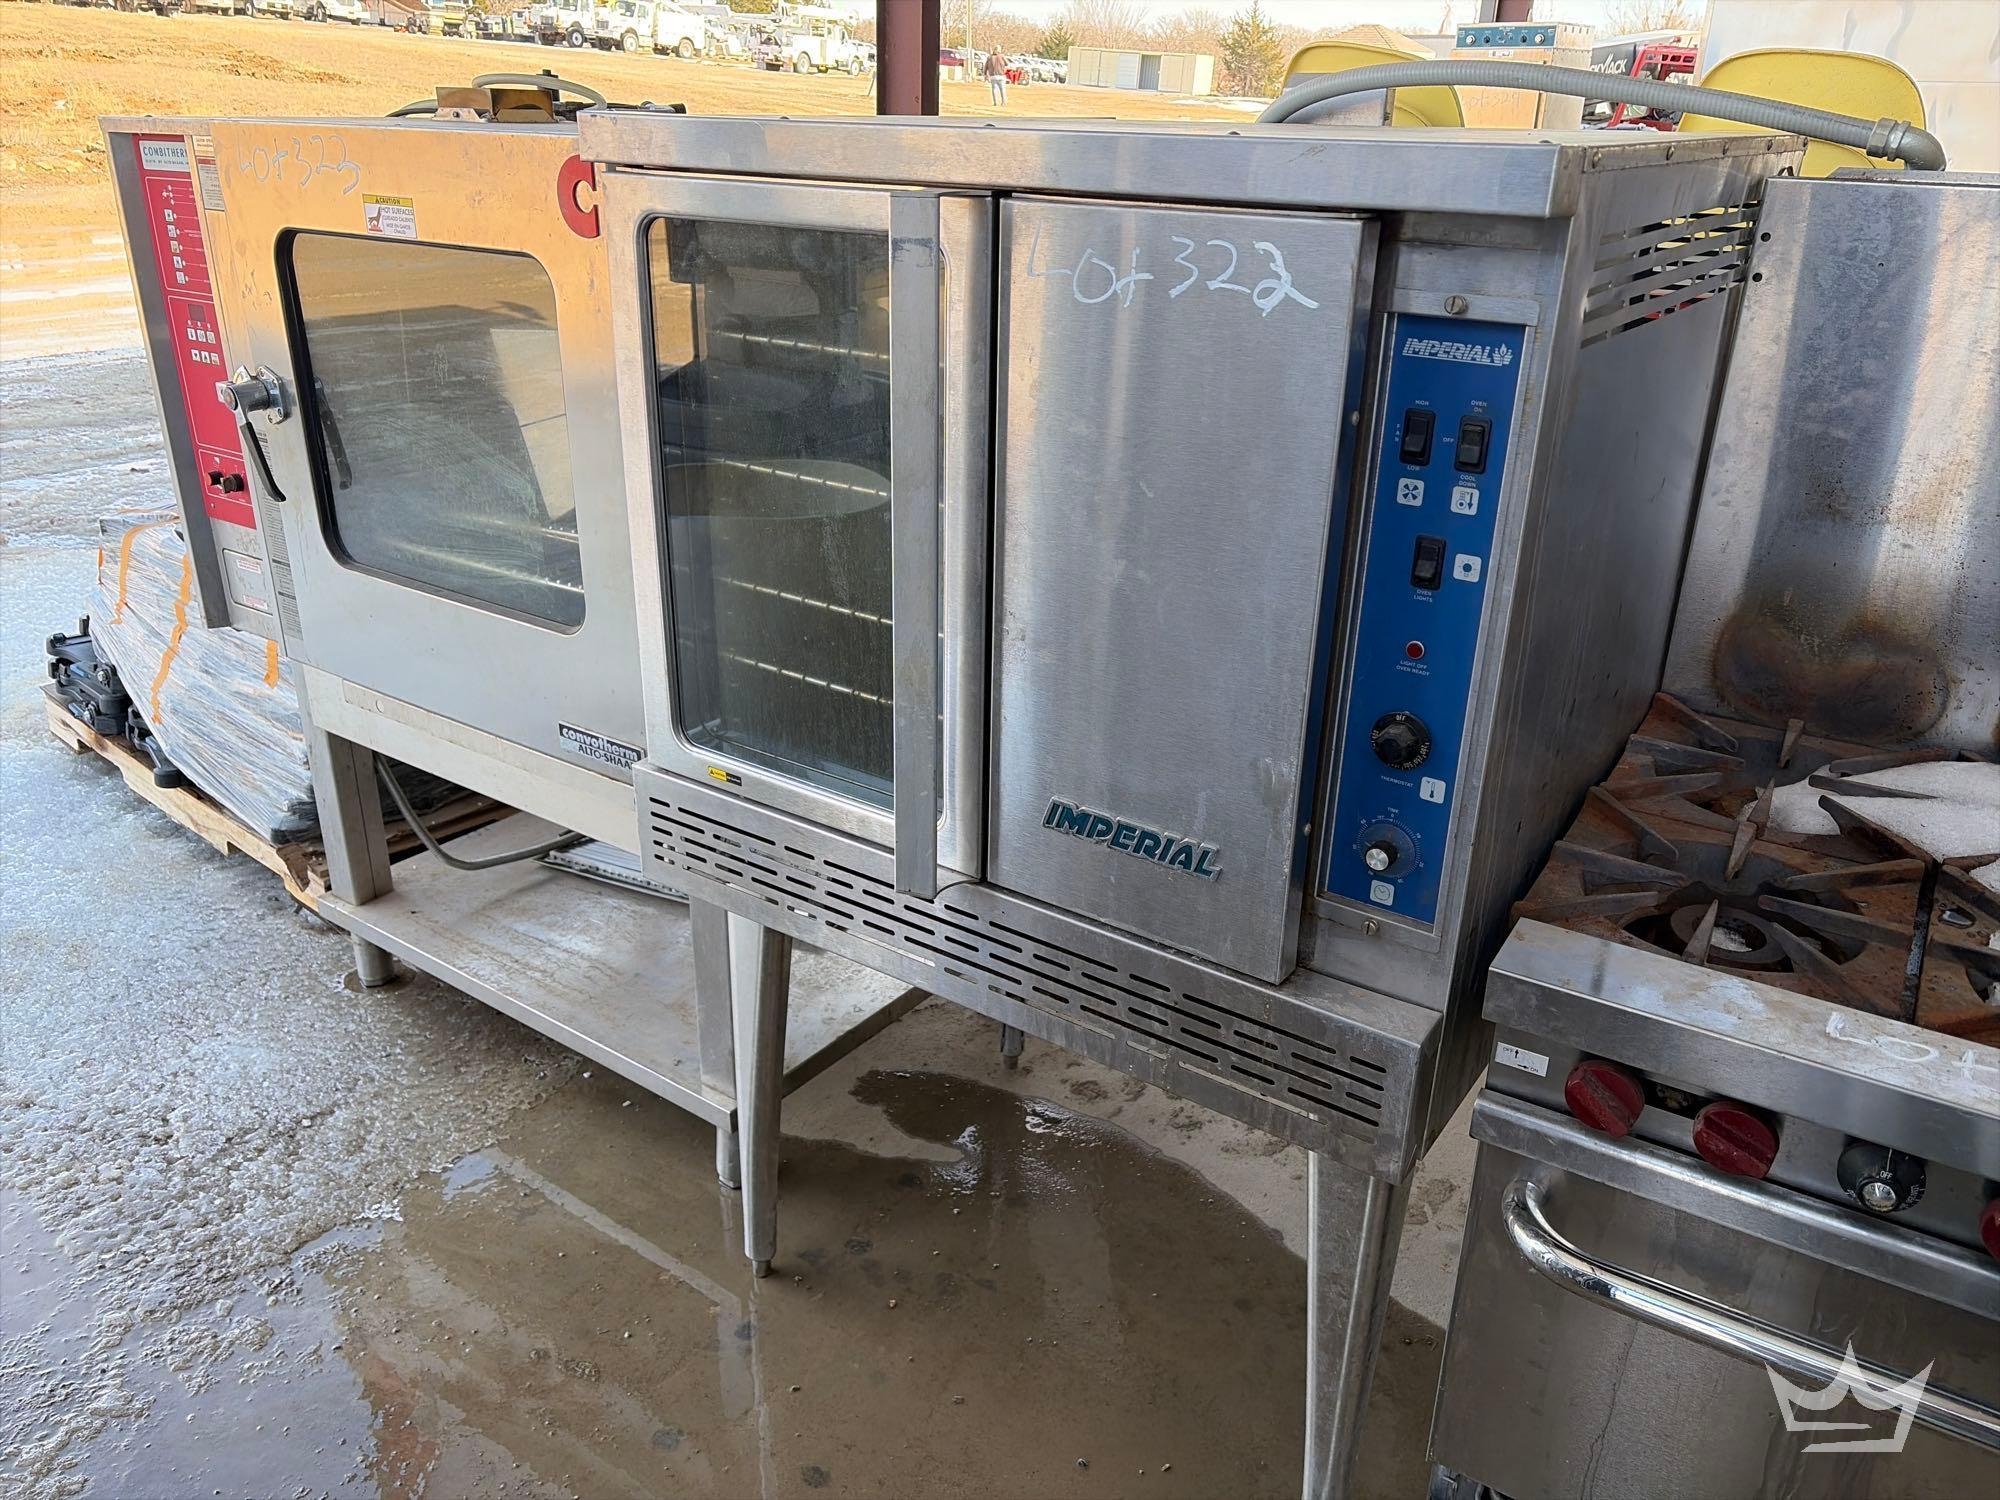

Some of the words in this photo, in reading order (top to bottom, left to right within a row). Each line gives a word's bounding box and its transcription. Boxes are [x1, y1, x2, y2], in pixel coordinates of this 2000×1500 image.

[1028, 220, 1154, 308] Lot
[1168, 235, 1320, 317] 322
[1402, 337, 1502, 366] IMPERIAL
[1470, 399, 1488, 407] OVEN
[1459, 474, 1477, 482] COOL
[1416, 589, 1432, 597] OVEN
[1413, 594, 1433, 603] LIGHTS
[1395, 664, 1411, 672] OVEN
[1399, 659, 1416, 667] LIGHT
[1416, 662, 1428, 670] OFF
[561, 727, 638, 762] convotherm
[1380, 775, 1415, 788] THERMOSTAT
[1042, 795, 1223, 881] IMPERIAL
[1879, 1170, 1893, 1180] OFF
